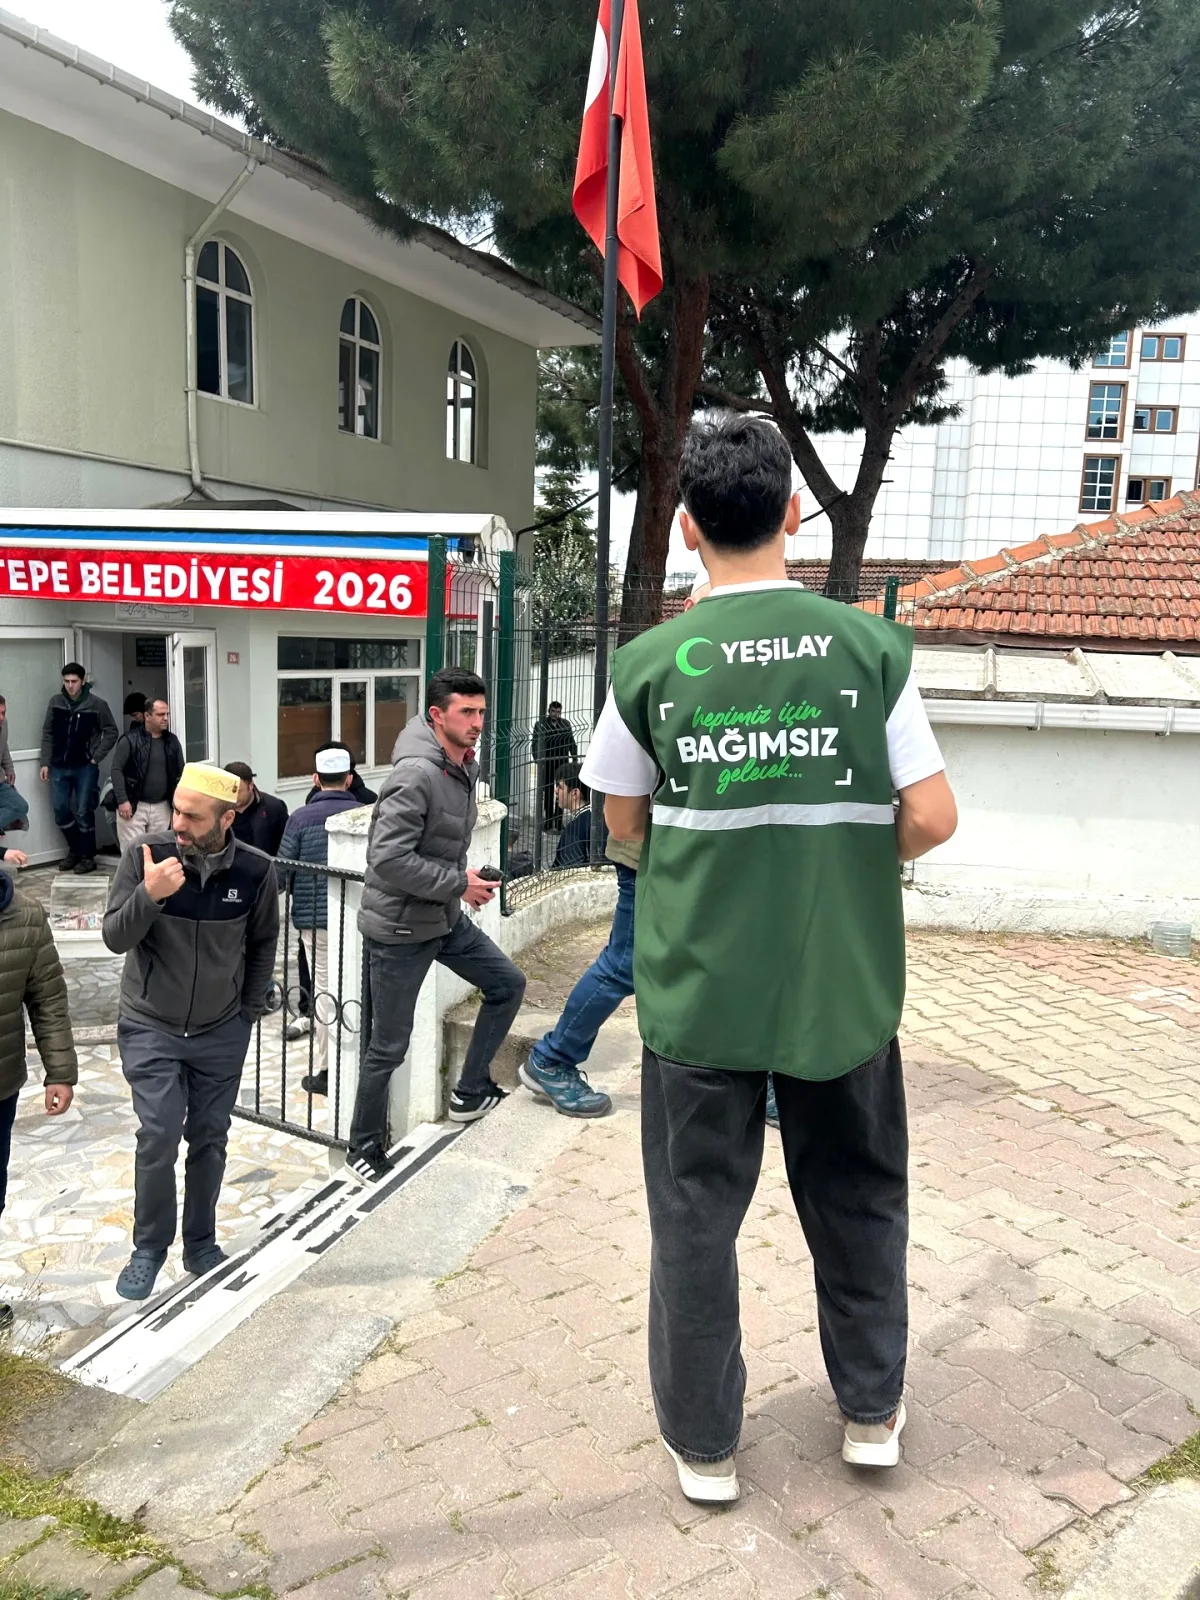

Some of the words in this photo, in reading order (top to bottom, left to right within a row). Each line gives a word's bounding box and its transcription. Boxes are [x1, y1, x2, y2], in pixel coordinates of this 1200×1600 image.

[80, 558, 284, 603] BELEDİYESİ
[315, 571, 412, 610] 2026
[692, 705, 772, 733] hepimiz
[778, 701, 821, 728] için
[676, 727, 839, 763] BAĞIMSIZ
